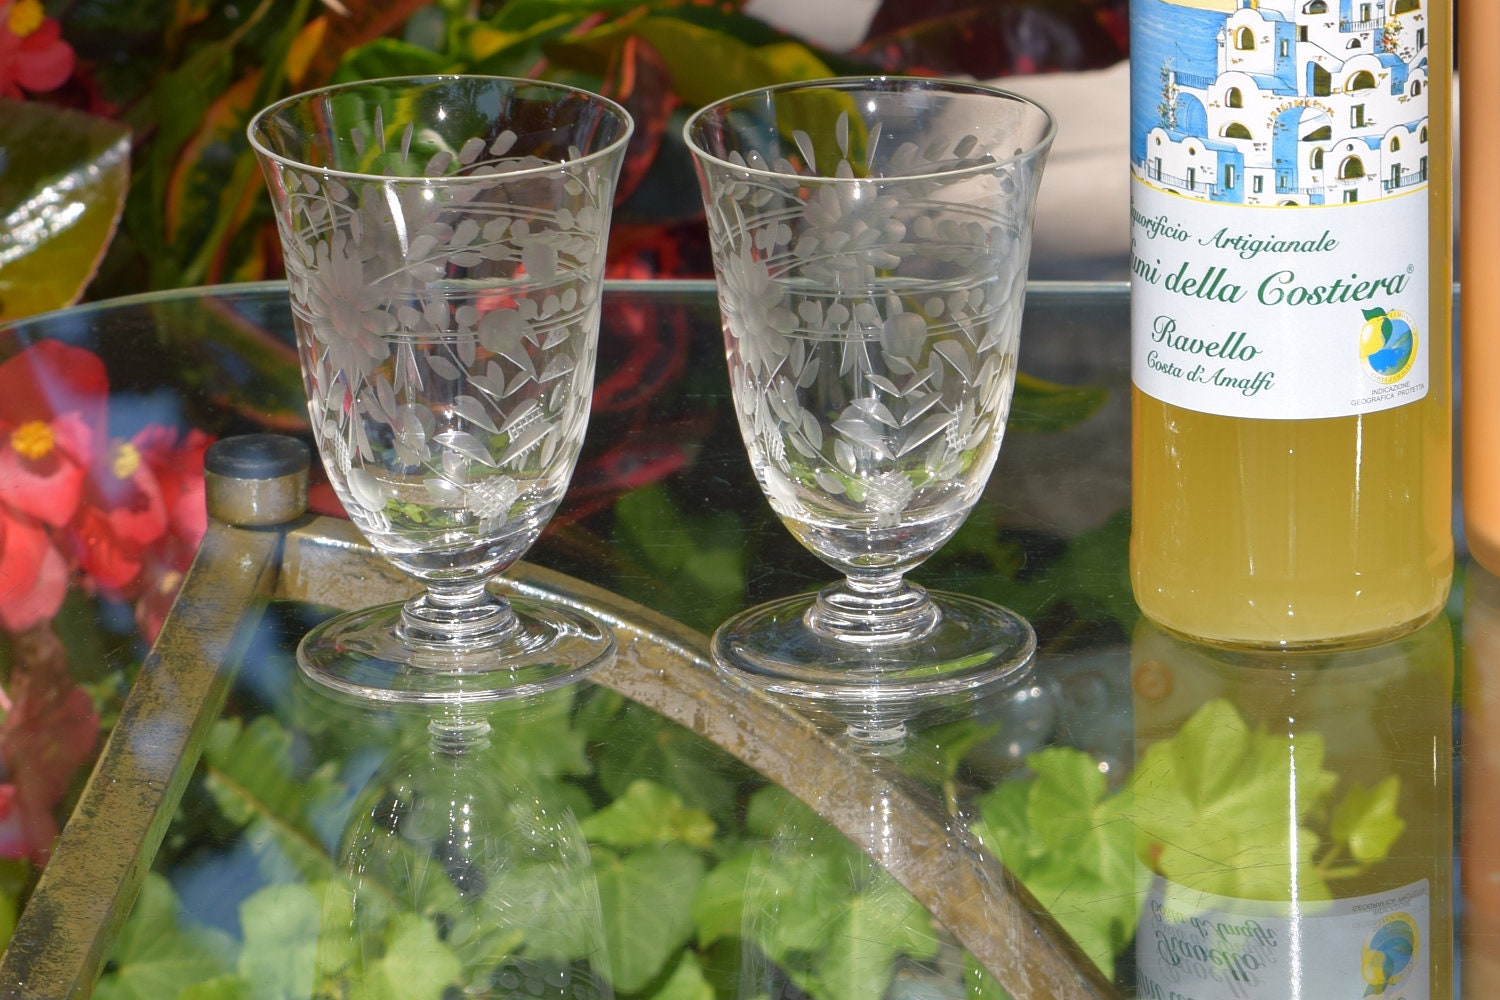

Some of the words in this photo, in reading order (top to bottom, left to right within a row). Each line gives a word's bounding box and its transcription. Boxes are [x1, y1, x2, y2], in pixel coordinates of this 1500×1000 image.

[1198, 227, 1340, 259] Artigianale
[1165, 261, 1247, 303] della
[1151, 315, 1262, 361] Ravello
[1147, 350, 1184, 380] Costa
[1350, 393, 1395, 406] GEOGRAFICA
